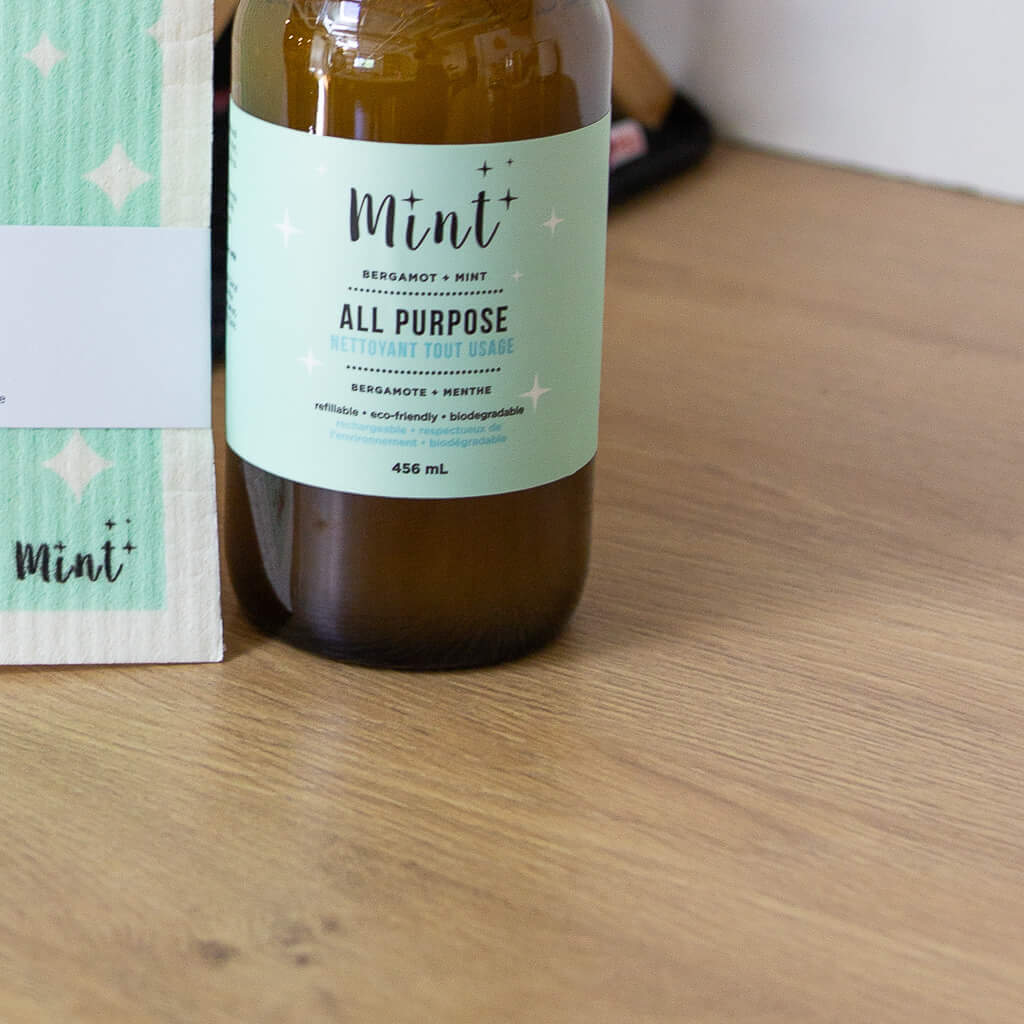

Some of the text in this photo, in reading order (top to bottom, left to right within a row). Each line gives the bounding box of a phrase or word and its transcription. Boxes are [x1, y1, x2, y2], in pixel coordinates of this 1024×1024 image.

[349, 187, 501, 251] Mint
[362, 270, 437, 283] BERGAMOT
[455, 272, 488, 283] MINT
[339, 303, 509, 336] ALL PURPOSE
[330, 334, 515, 359] NETTOYANT TOUT USAGE
[351, 383, 427, 397] BERGAMOTE
[443, 385, 492, 397] MENTHE
[314, 401, 525, 424] refillable eco-friendly biodegradable
[392, 462, 449, 475] 456 mL
[15, 540, 124, 584] Mint
